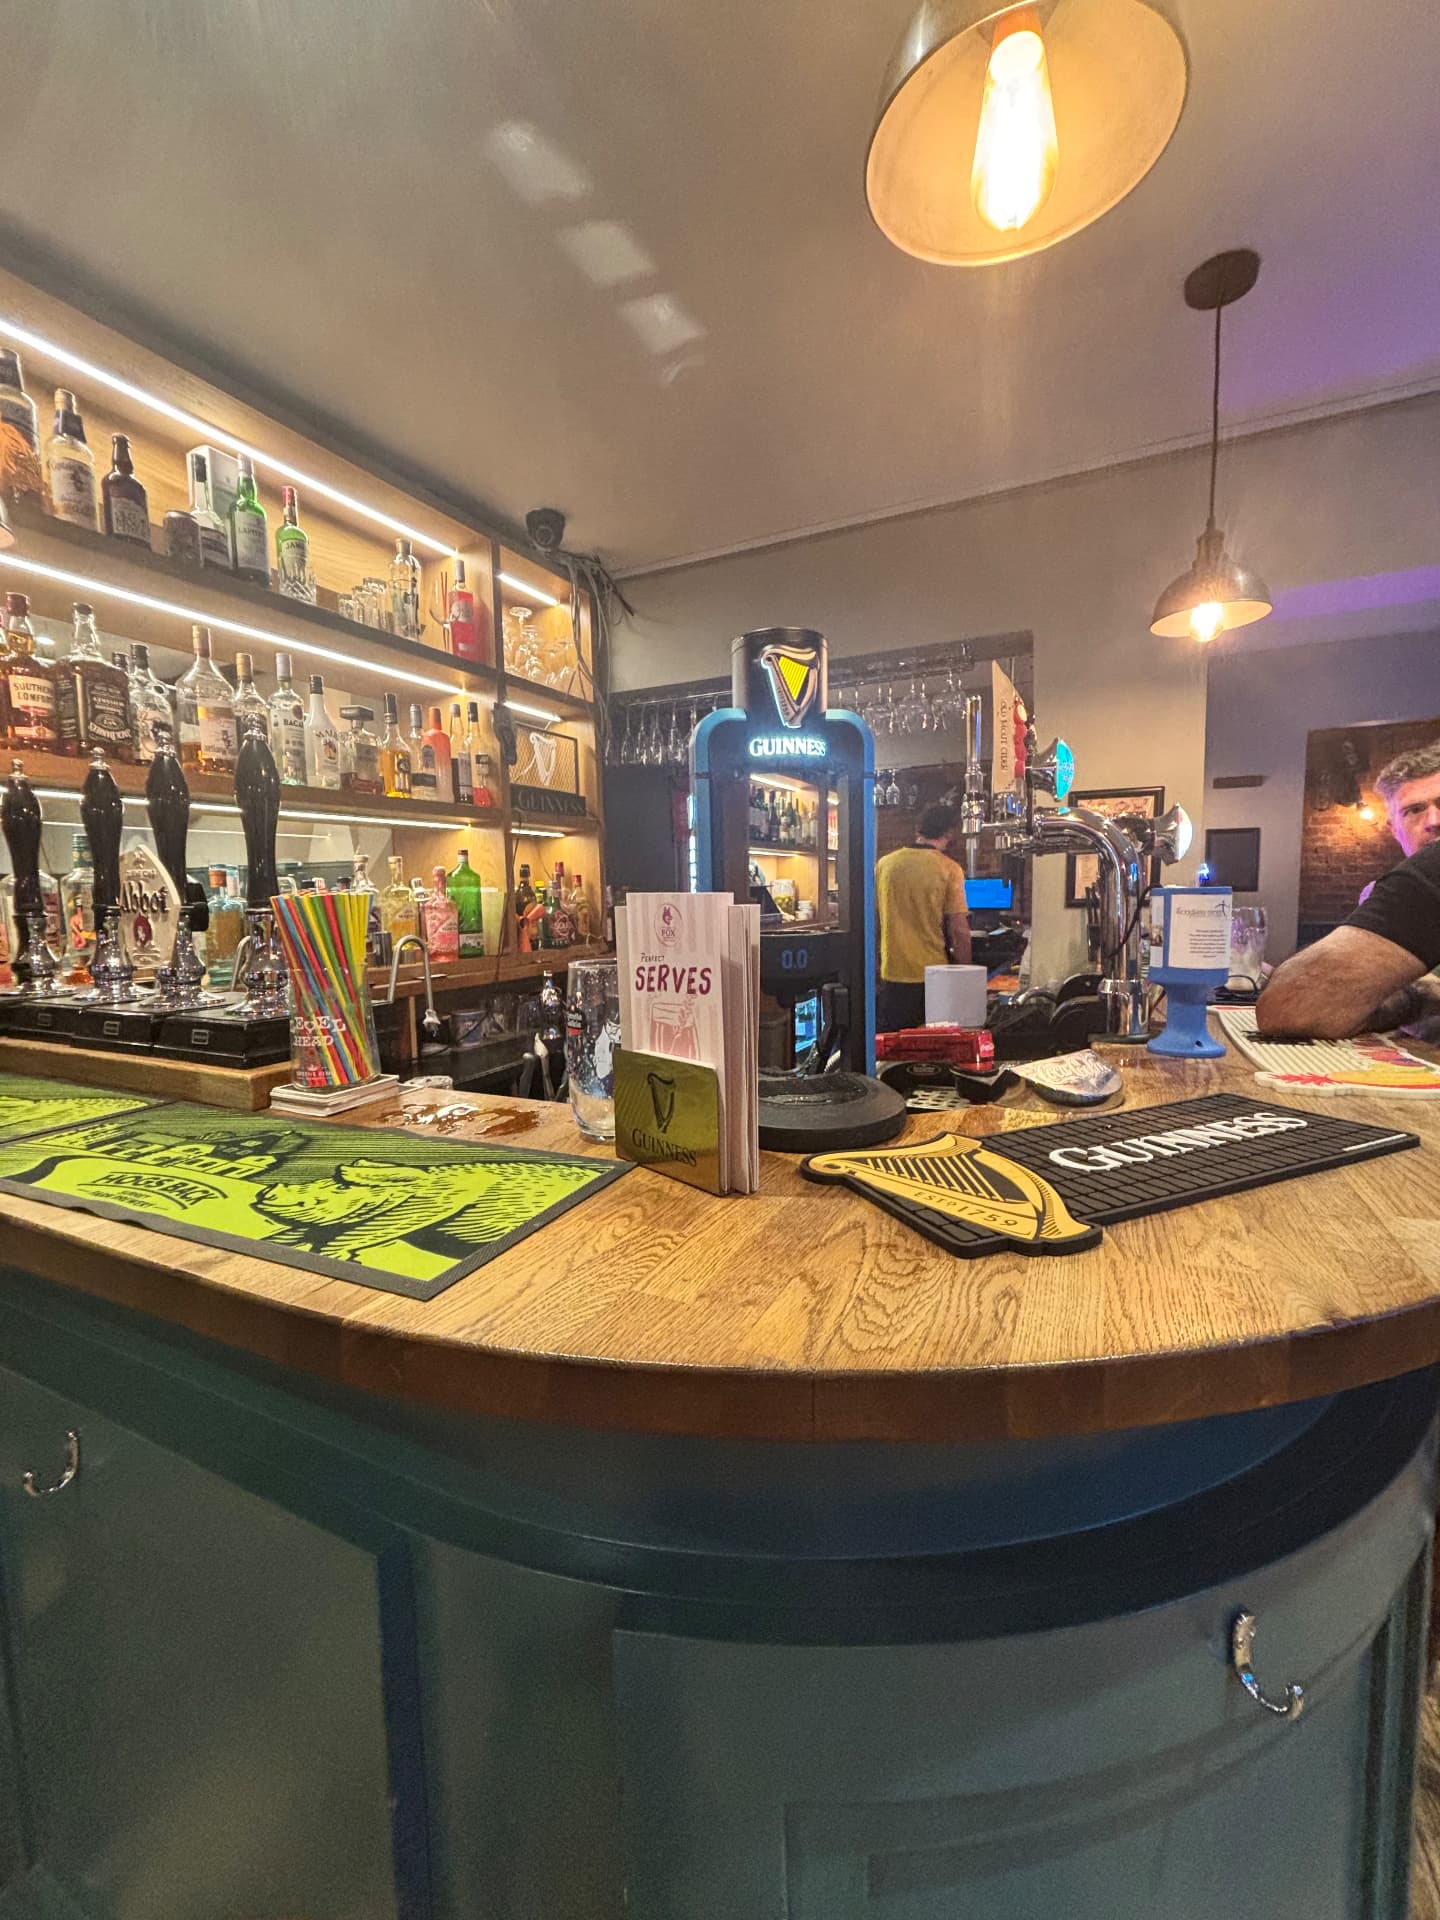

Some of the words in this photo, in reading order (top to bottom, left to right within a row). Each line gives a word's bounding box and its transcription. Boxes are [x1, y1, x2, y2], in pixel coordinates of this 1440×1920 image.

[749, 737, 826, 757] GUINNESS
[660, 928, 676, 938] FOX
[635, 963, 712, 995] SERVES
[632, 1128, 697, 1167] GUINNESS
[1049, 1112, 1308, 1172] GUINNESS
[92, 1174, 174, 1188] HOGS
[158, 1180, 219, 1205] BACK
[957, 1206, 1018, 1226] 1759
